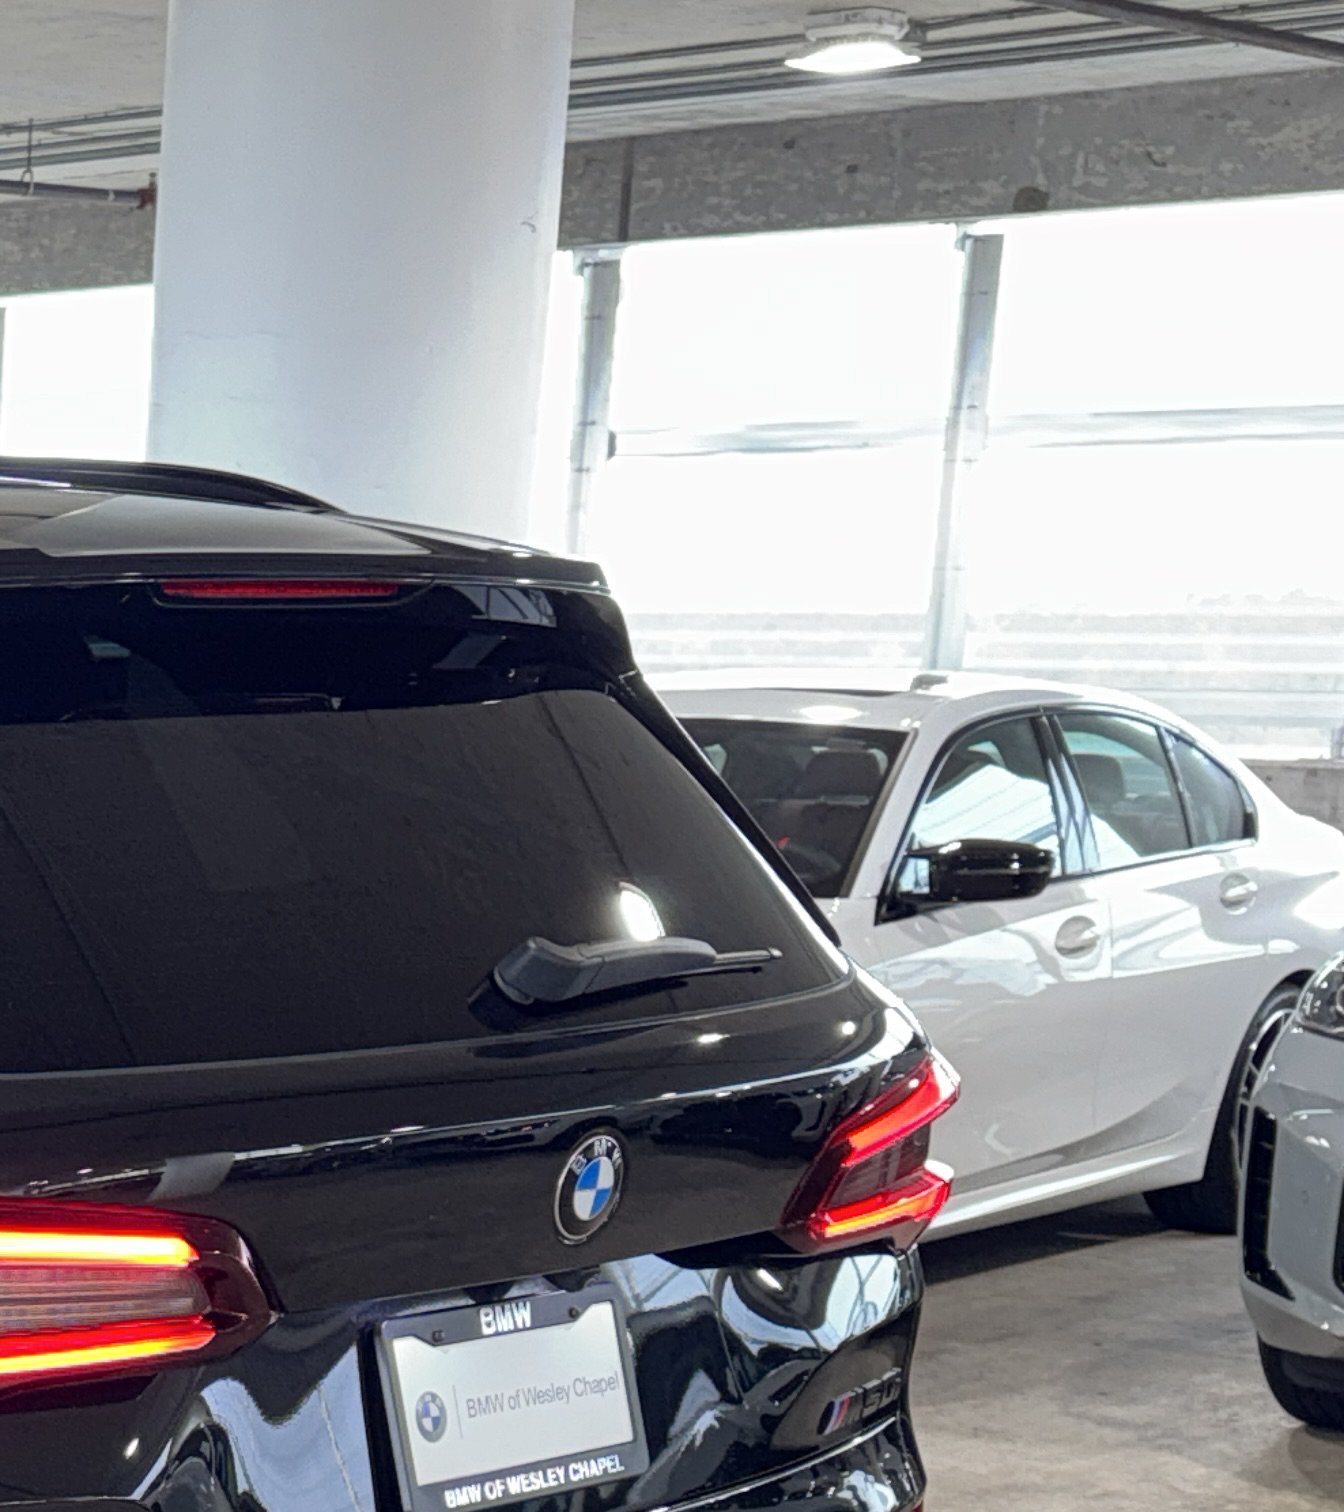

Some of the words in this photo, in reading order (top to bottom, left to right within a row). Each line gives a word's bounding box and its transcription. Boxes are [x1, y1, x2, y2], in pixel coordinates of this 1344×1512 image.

[480, 1301, 531, 1335] BMW
[466, 1395, 504, 1418] BMW
[508, 1393, 522, 1410] of
[521, 1383, 570, 1406] Wesley
[572, 1371, 620, 1397] Chapel
[444, 1482, 482, 1508] BMW
[484, 1479, 505, 1500] OF
[506, 1465, 565, 1494] WESLEY
[568, 1454, 624, 1483] CHAPEL
